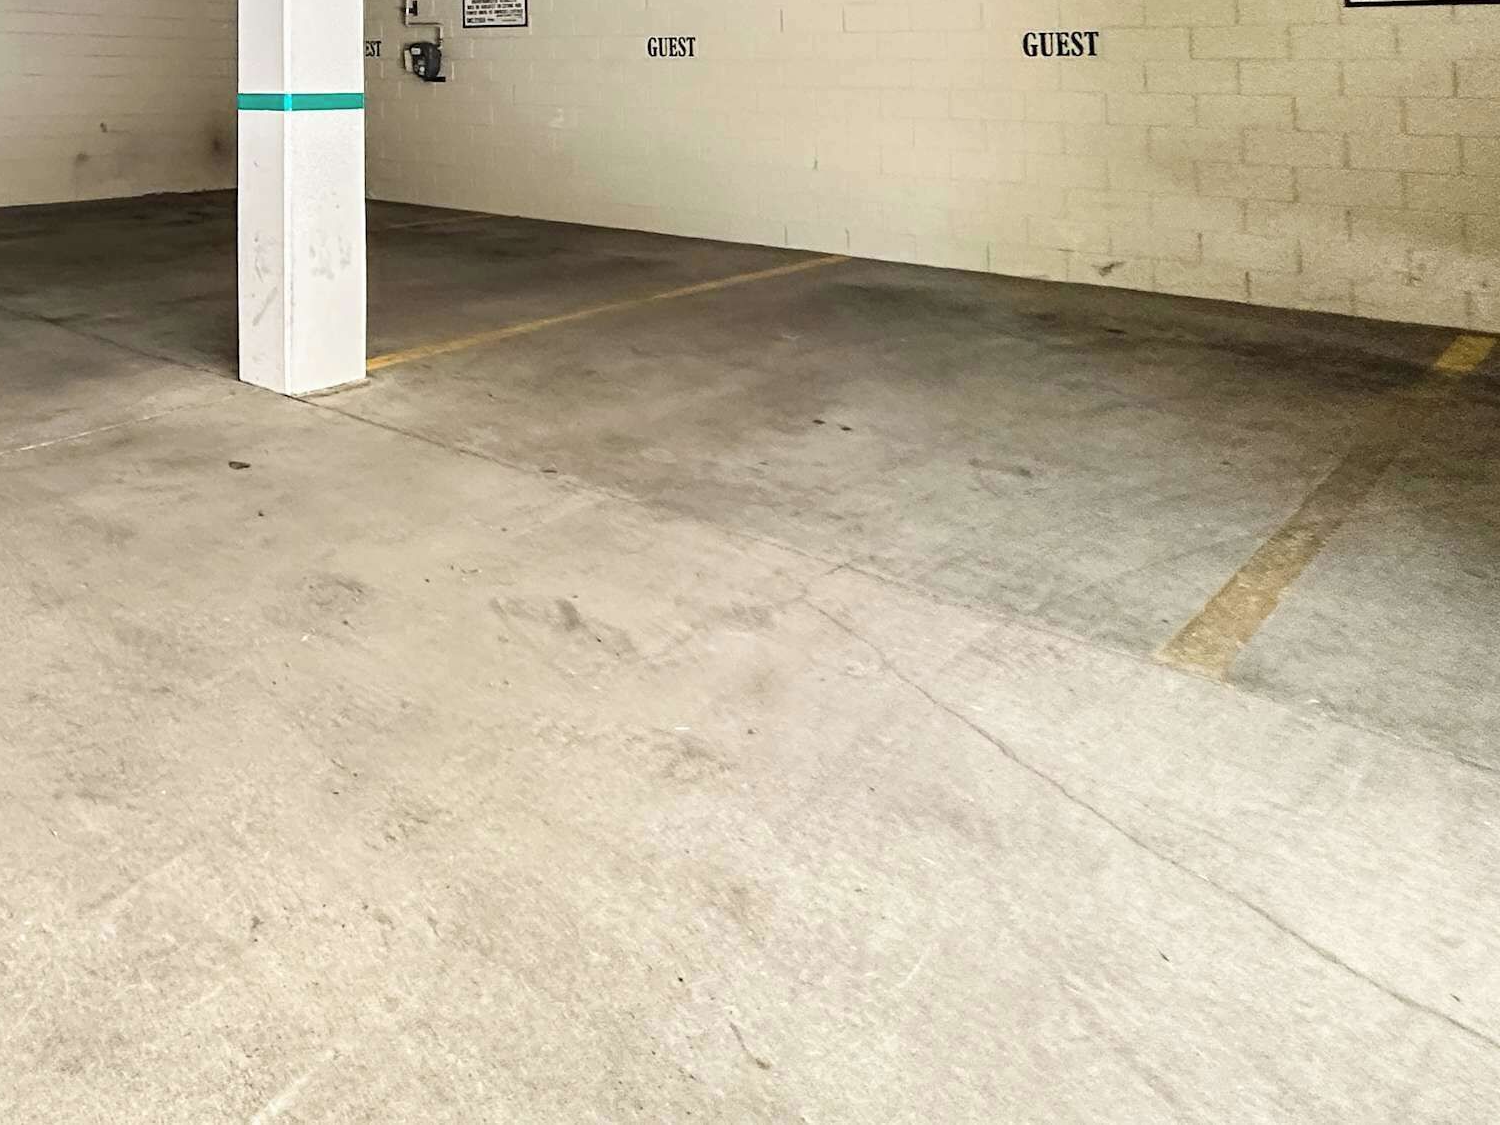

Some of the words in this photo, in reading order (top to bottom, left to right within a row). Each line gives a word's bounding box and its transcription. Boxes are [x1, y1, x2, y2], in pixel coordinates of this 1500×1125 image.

[364, 40, 382, 57] EST
[647, 36, 696, 57] GUEST
[1022, 31, 1100, 57] GUEST
